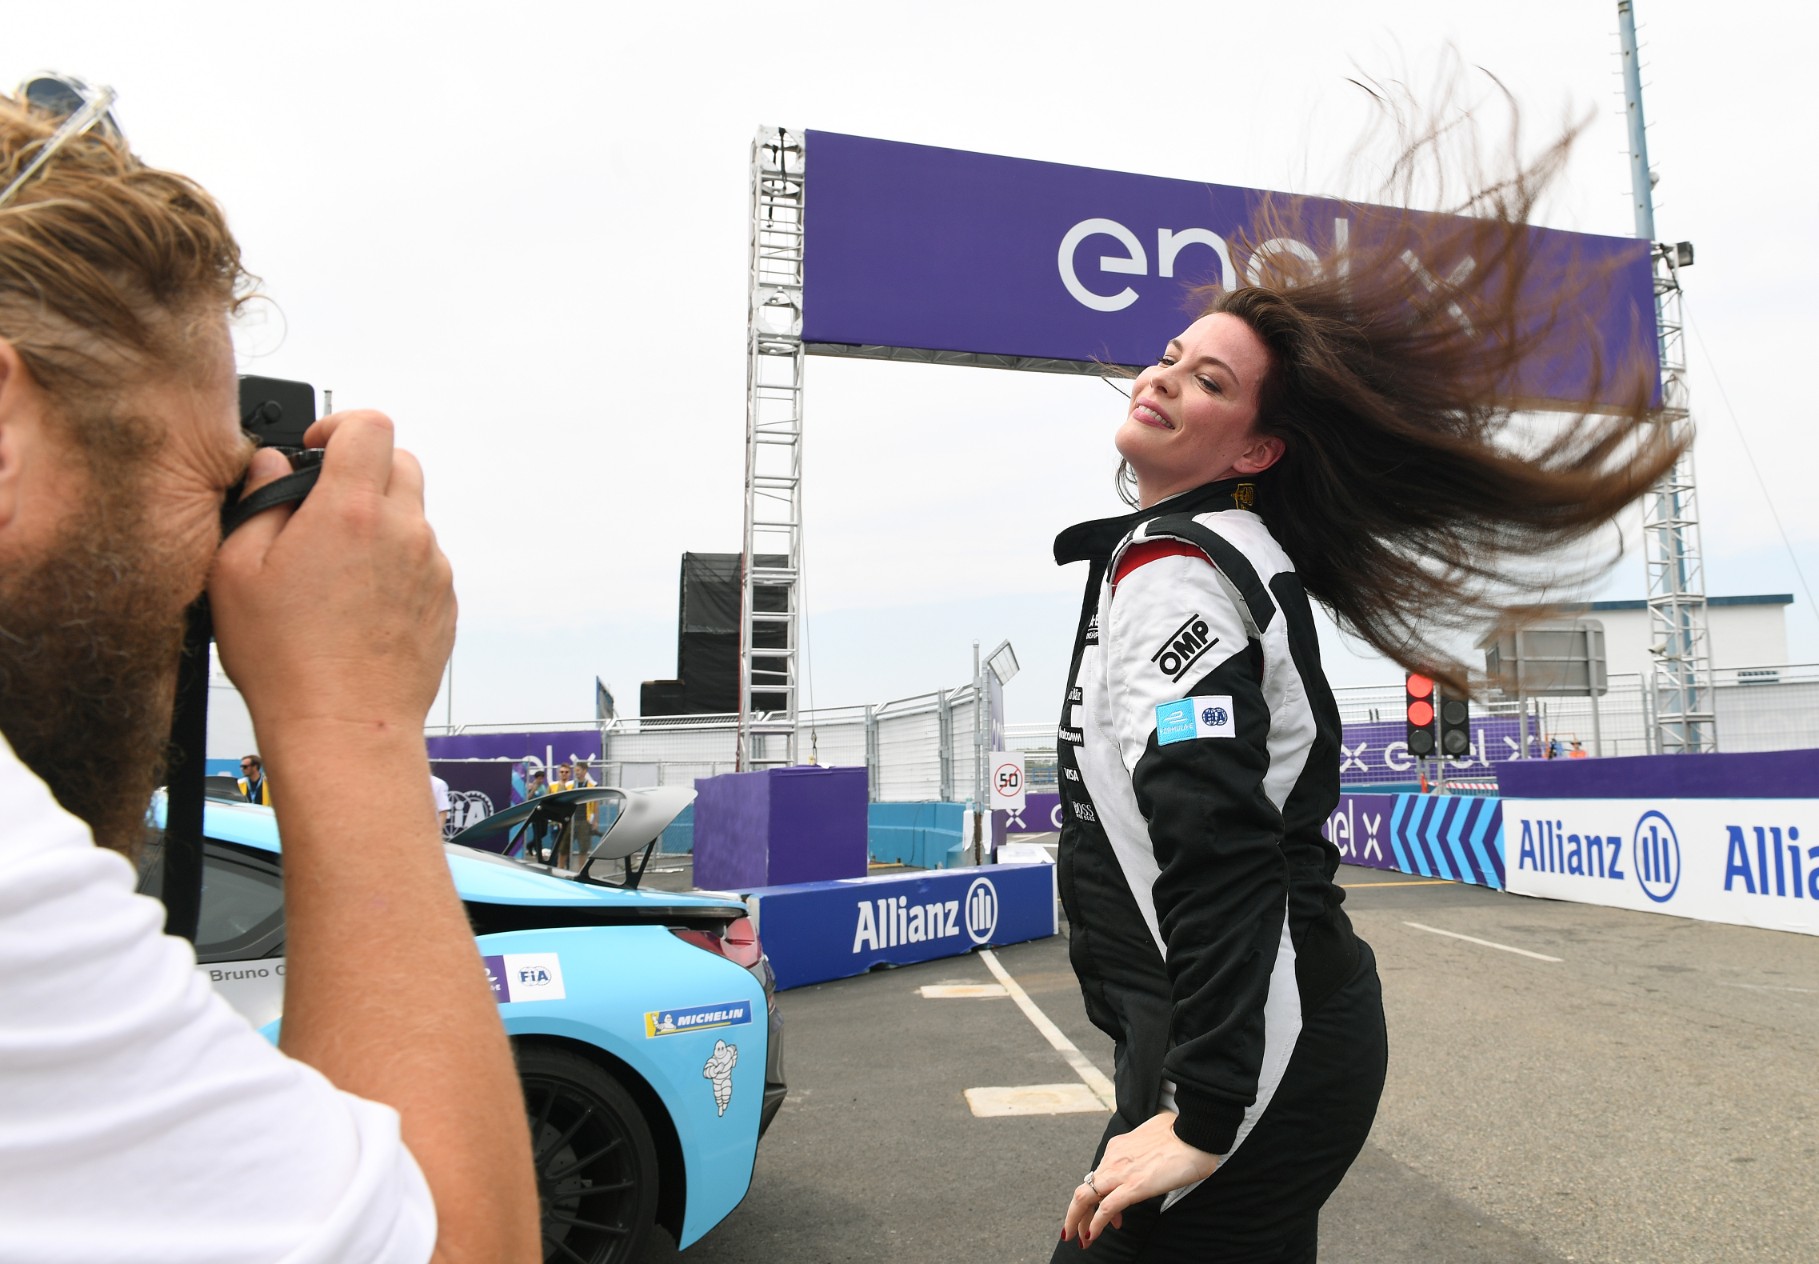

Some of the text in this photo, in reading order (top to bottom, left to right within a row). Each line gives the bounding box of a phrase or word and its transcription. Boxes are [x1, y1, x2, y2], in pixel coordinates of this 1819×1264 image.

[1159, 620, 1209, 675] OMP
[999, 773, 1018, 787] 50
[1063, 767, 1080, 782] VISA
[1519, 819, 1625, 880] Allianz
[852, 895, 960, 954] Allianz
[209, 968, 269, 982] Bruno
[677, 1008, 744, 1027] MICHELIN
